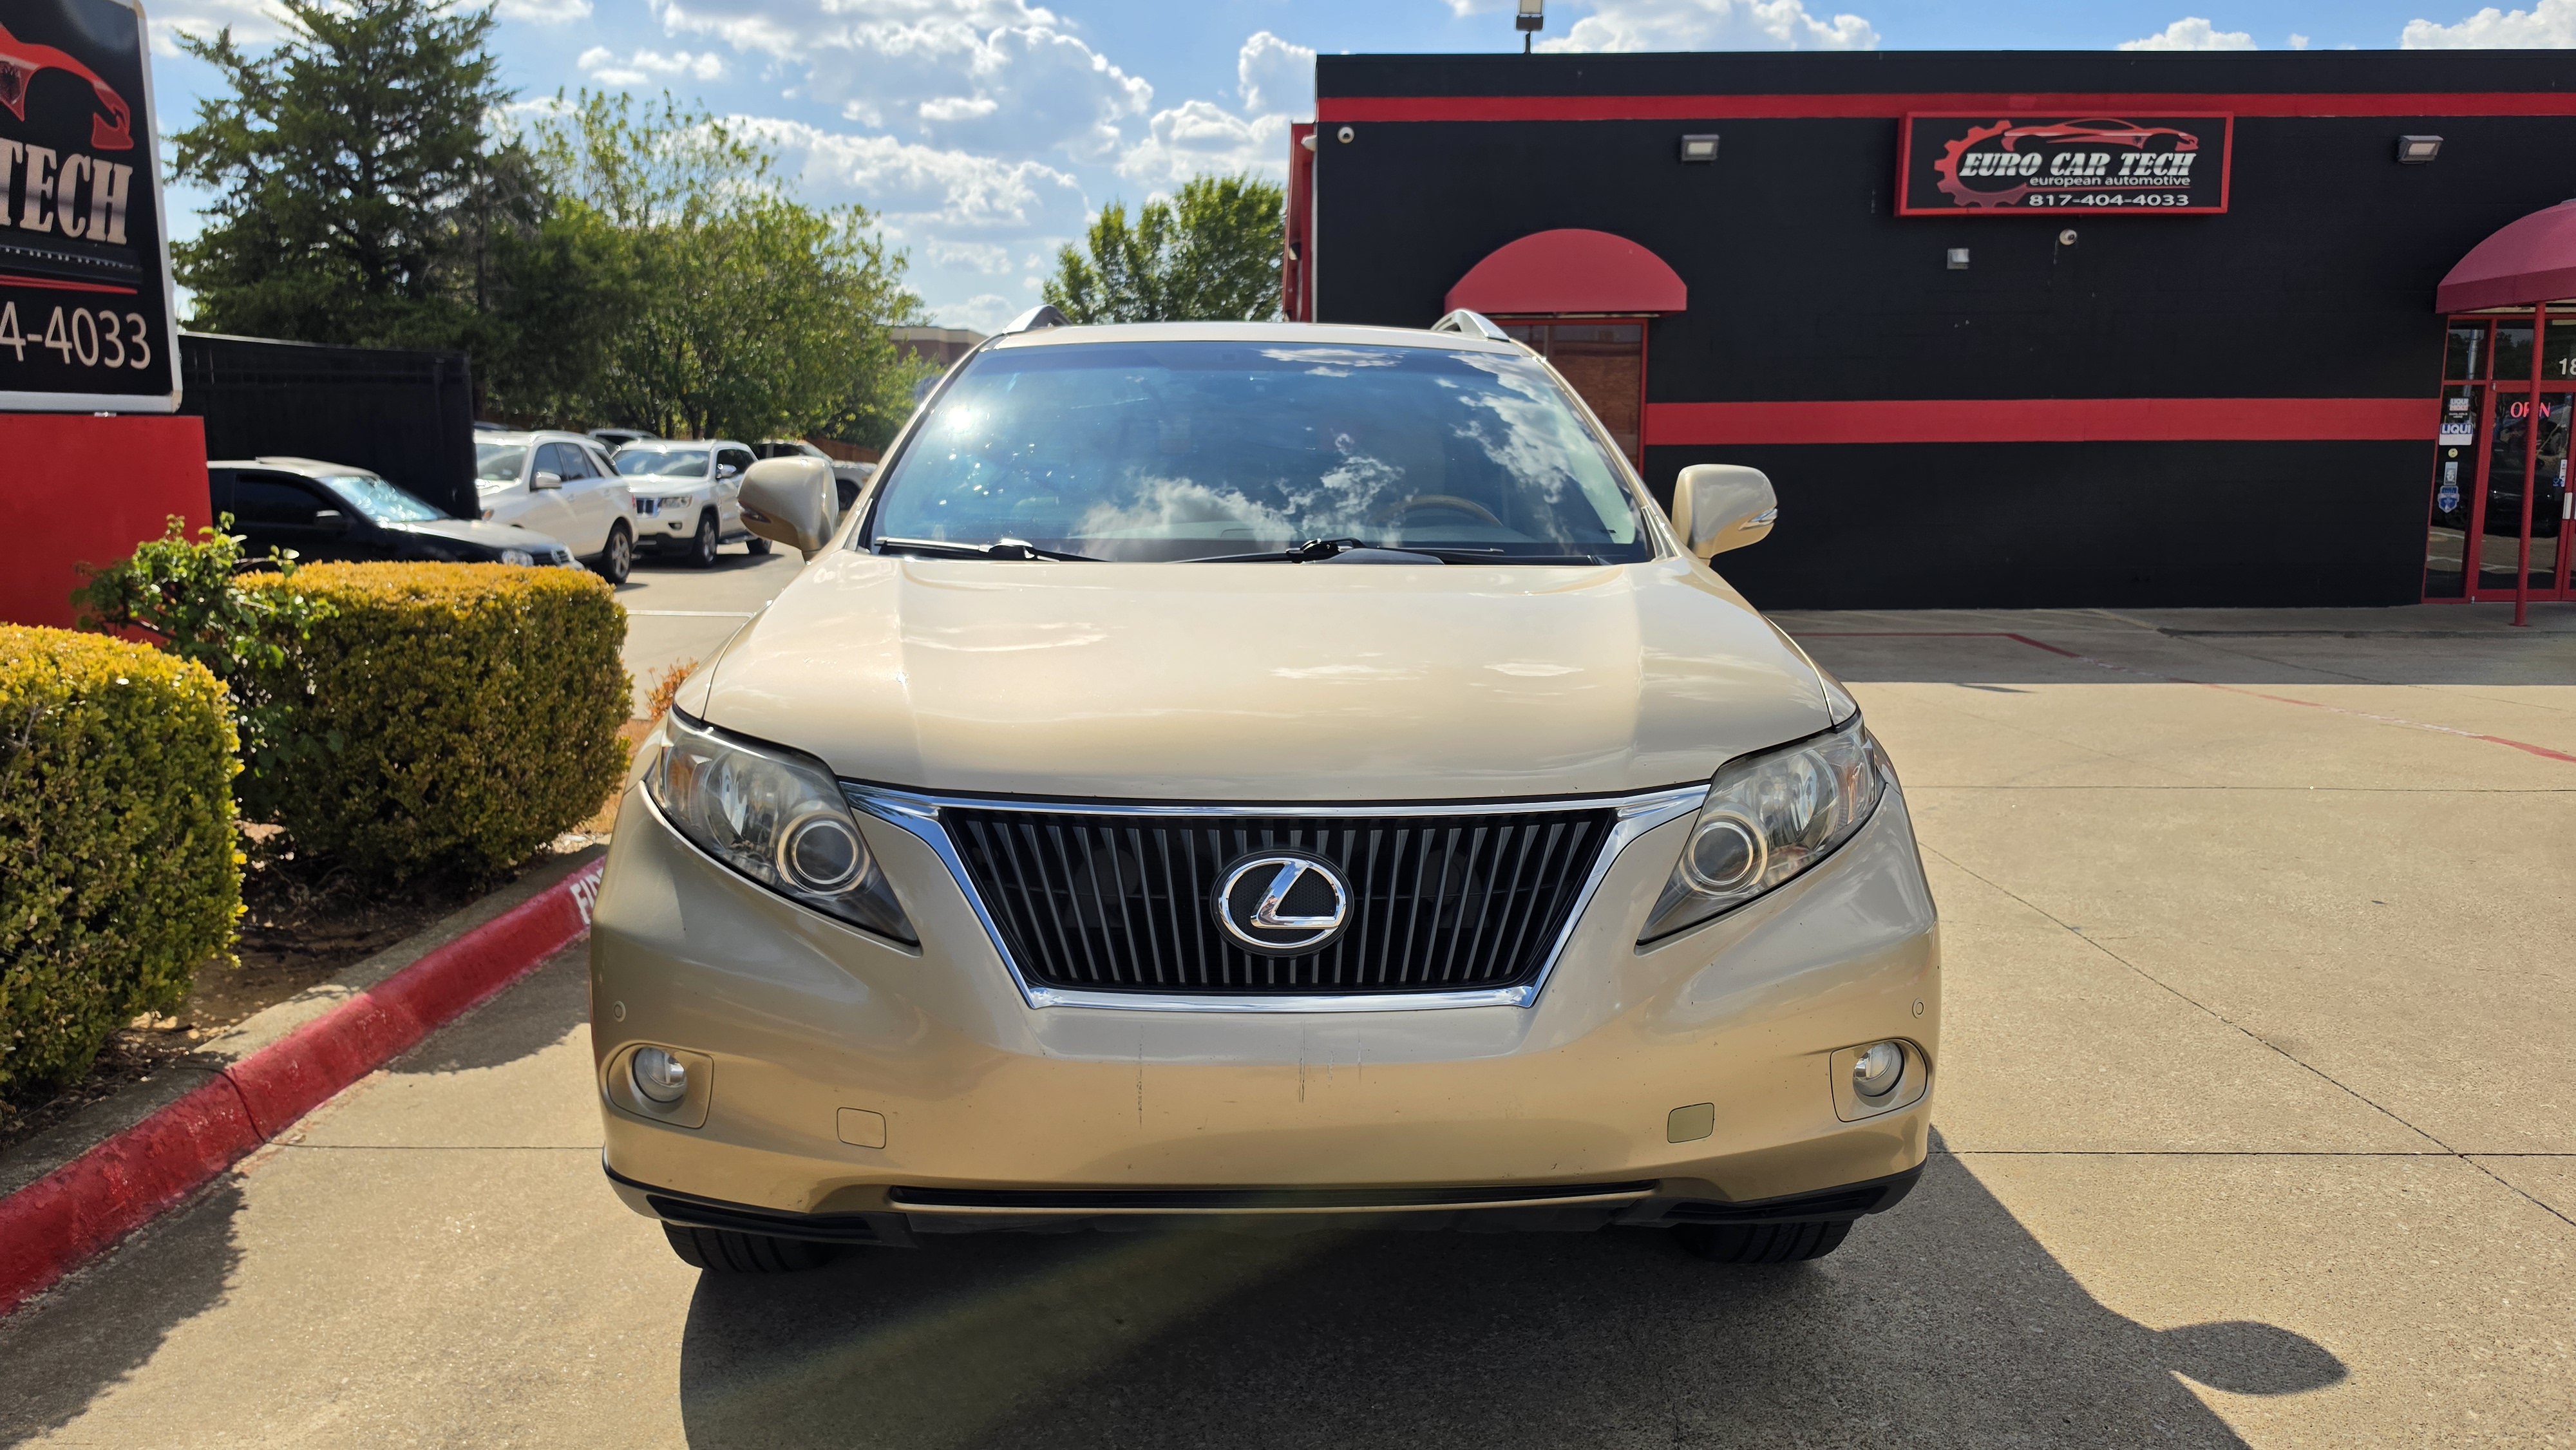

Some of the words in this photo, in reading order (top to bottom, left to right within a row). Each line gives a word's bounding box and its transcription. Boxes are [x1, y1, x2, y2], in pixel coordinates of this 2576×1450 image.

[1960, 153, 2042, 176] EURO
[2050, 153, 2110, 176] CAR
[2118, 153, 2197, 176] TECH
[2030, 176, 2101, 187] european
[2105, 176, 2191, 185] automotive
[2029, 194, 2189, 206] 817-404-4033
[0, 301, 151, 370] 4-4033
[2510, 402, 2550, 417] OPN
[2441, 424, 2471, 434] LIQUI
